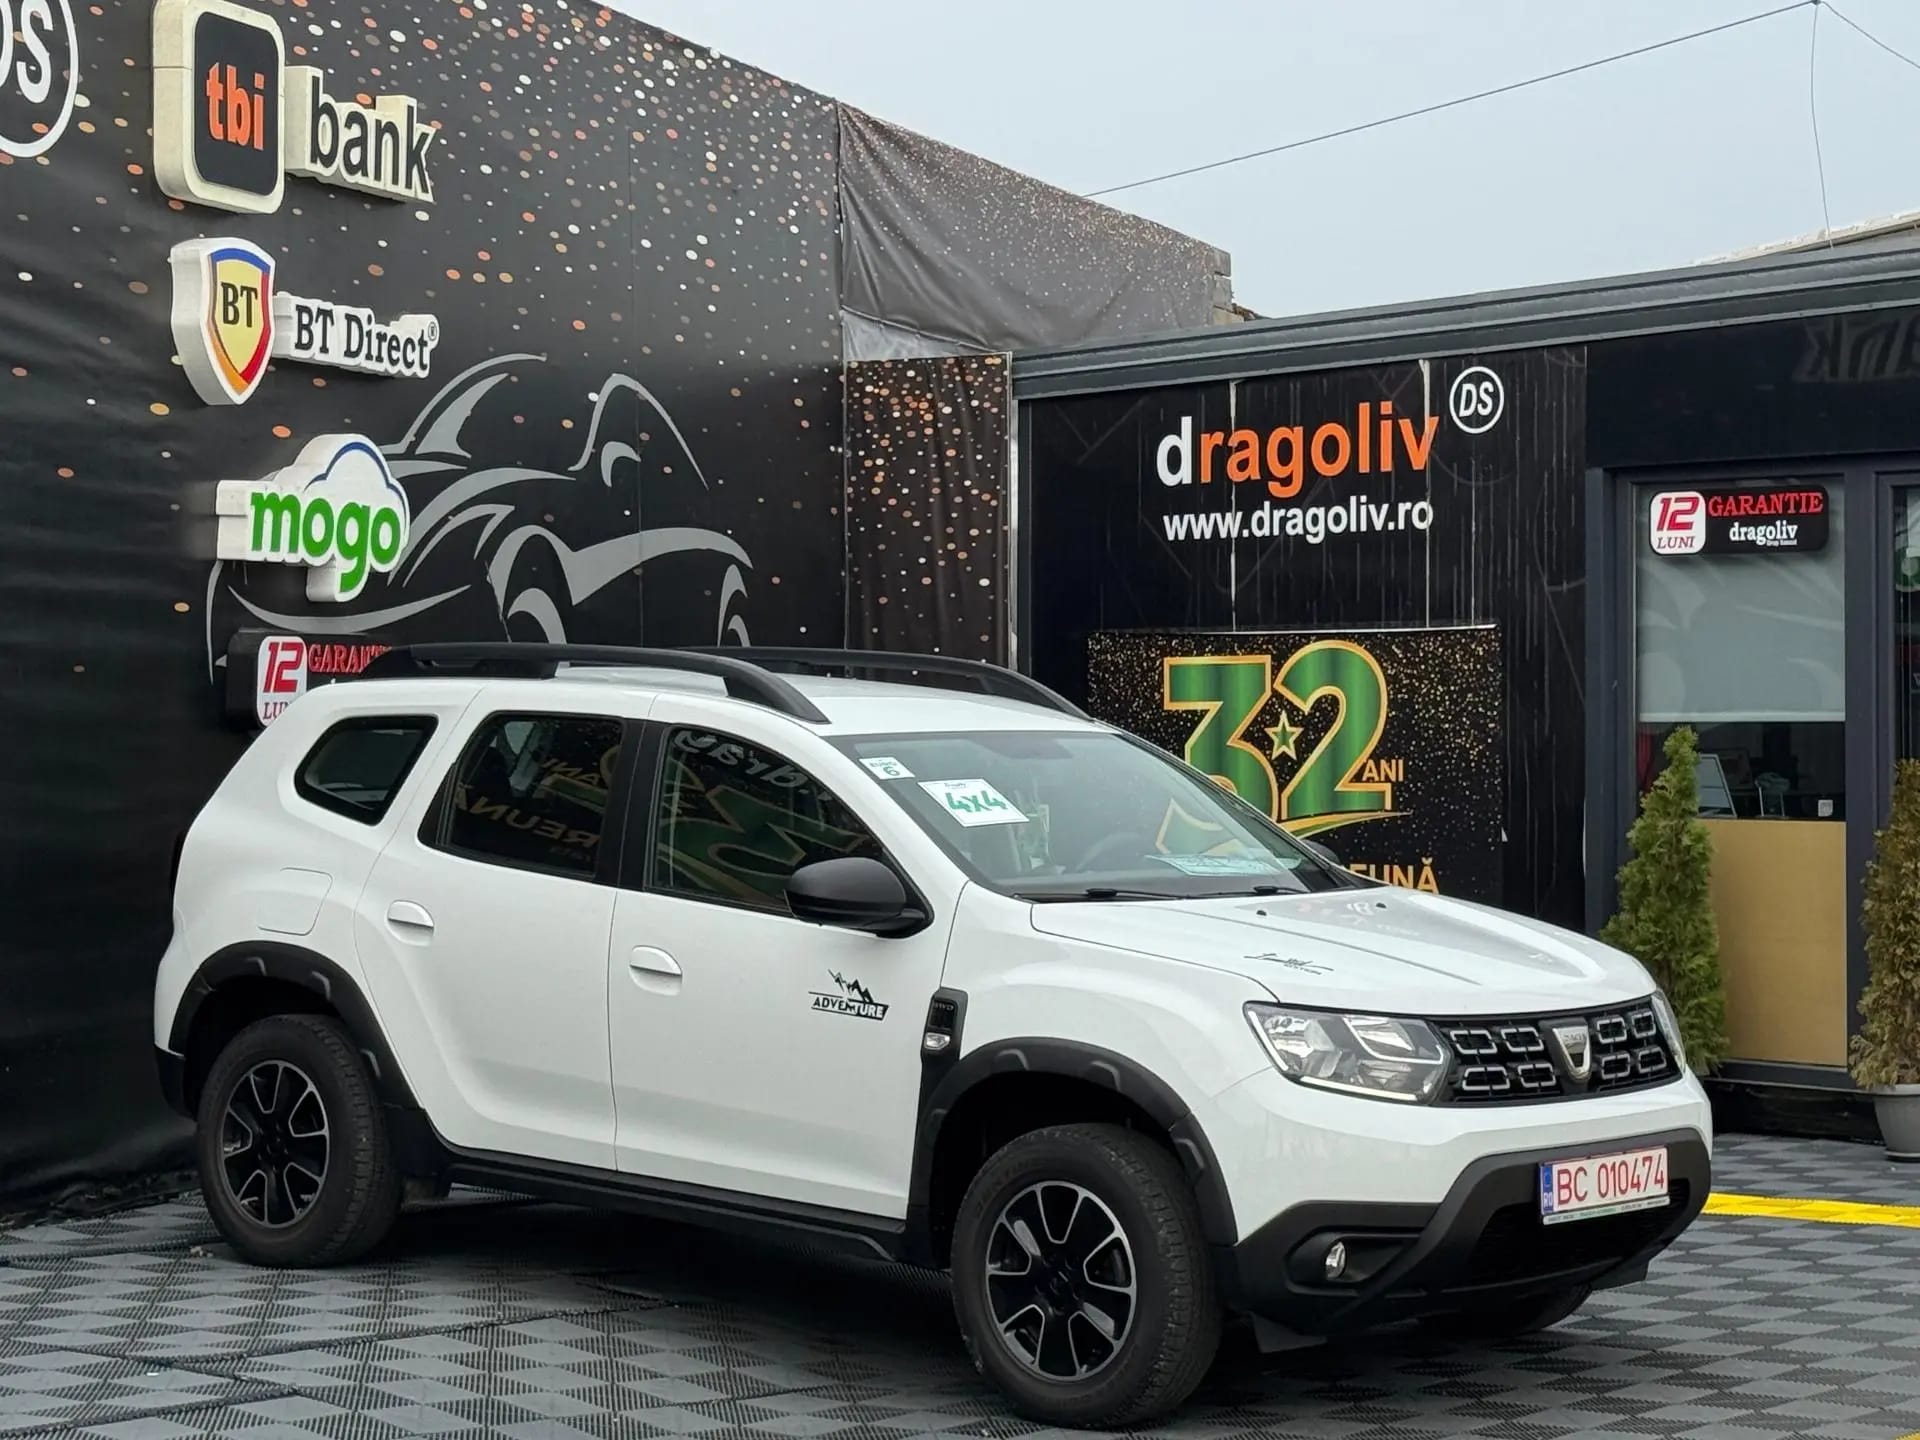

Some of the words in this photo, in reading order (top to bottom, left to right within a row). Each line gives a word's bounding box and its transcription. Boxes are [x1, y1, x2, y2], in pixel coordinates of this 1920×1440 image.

[206, 62, 265, 151] tbi
[309, 75, 430, 194] bank
[221, 282, 258, 328] BT
[295, 304, 335, 354] BT
[1459, 381, 1493, 417] DS
[1156, 401, 1440, 498] dragoliv
[1163, 495, 1434, 544] www.dragoliv.ro
[1656, 497, 1700, 532] 12
[1708, 491, 1824, 517] GARANTIE
[1729, 520, 1798, 545] dragoliv
[251, 491, 400, 593] mogo
[1657, 537, 1694, 550] LUNI
[263, 642, 304, 693] 12
[1159, 639, 1390, 838] 32
[883, 766, 900, 777] 6
[1362, 759, 1404, 782] ANI
[945, 789, 1008, 813] 4x4
[812, 996, 885, 1019] ADVENTURE
[1543, 1191, 1553, 1207] RO
[1556, 1165, 1588, 1207] BC
[1596, 1152, 1665, 1199] 010474
